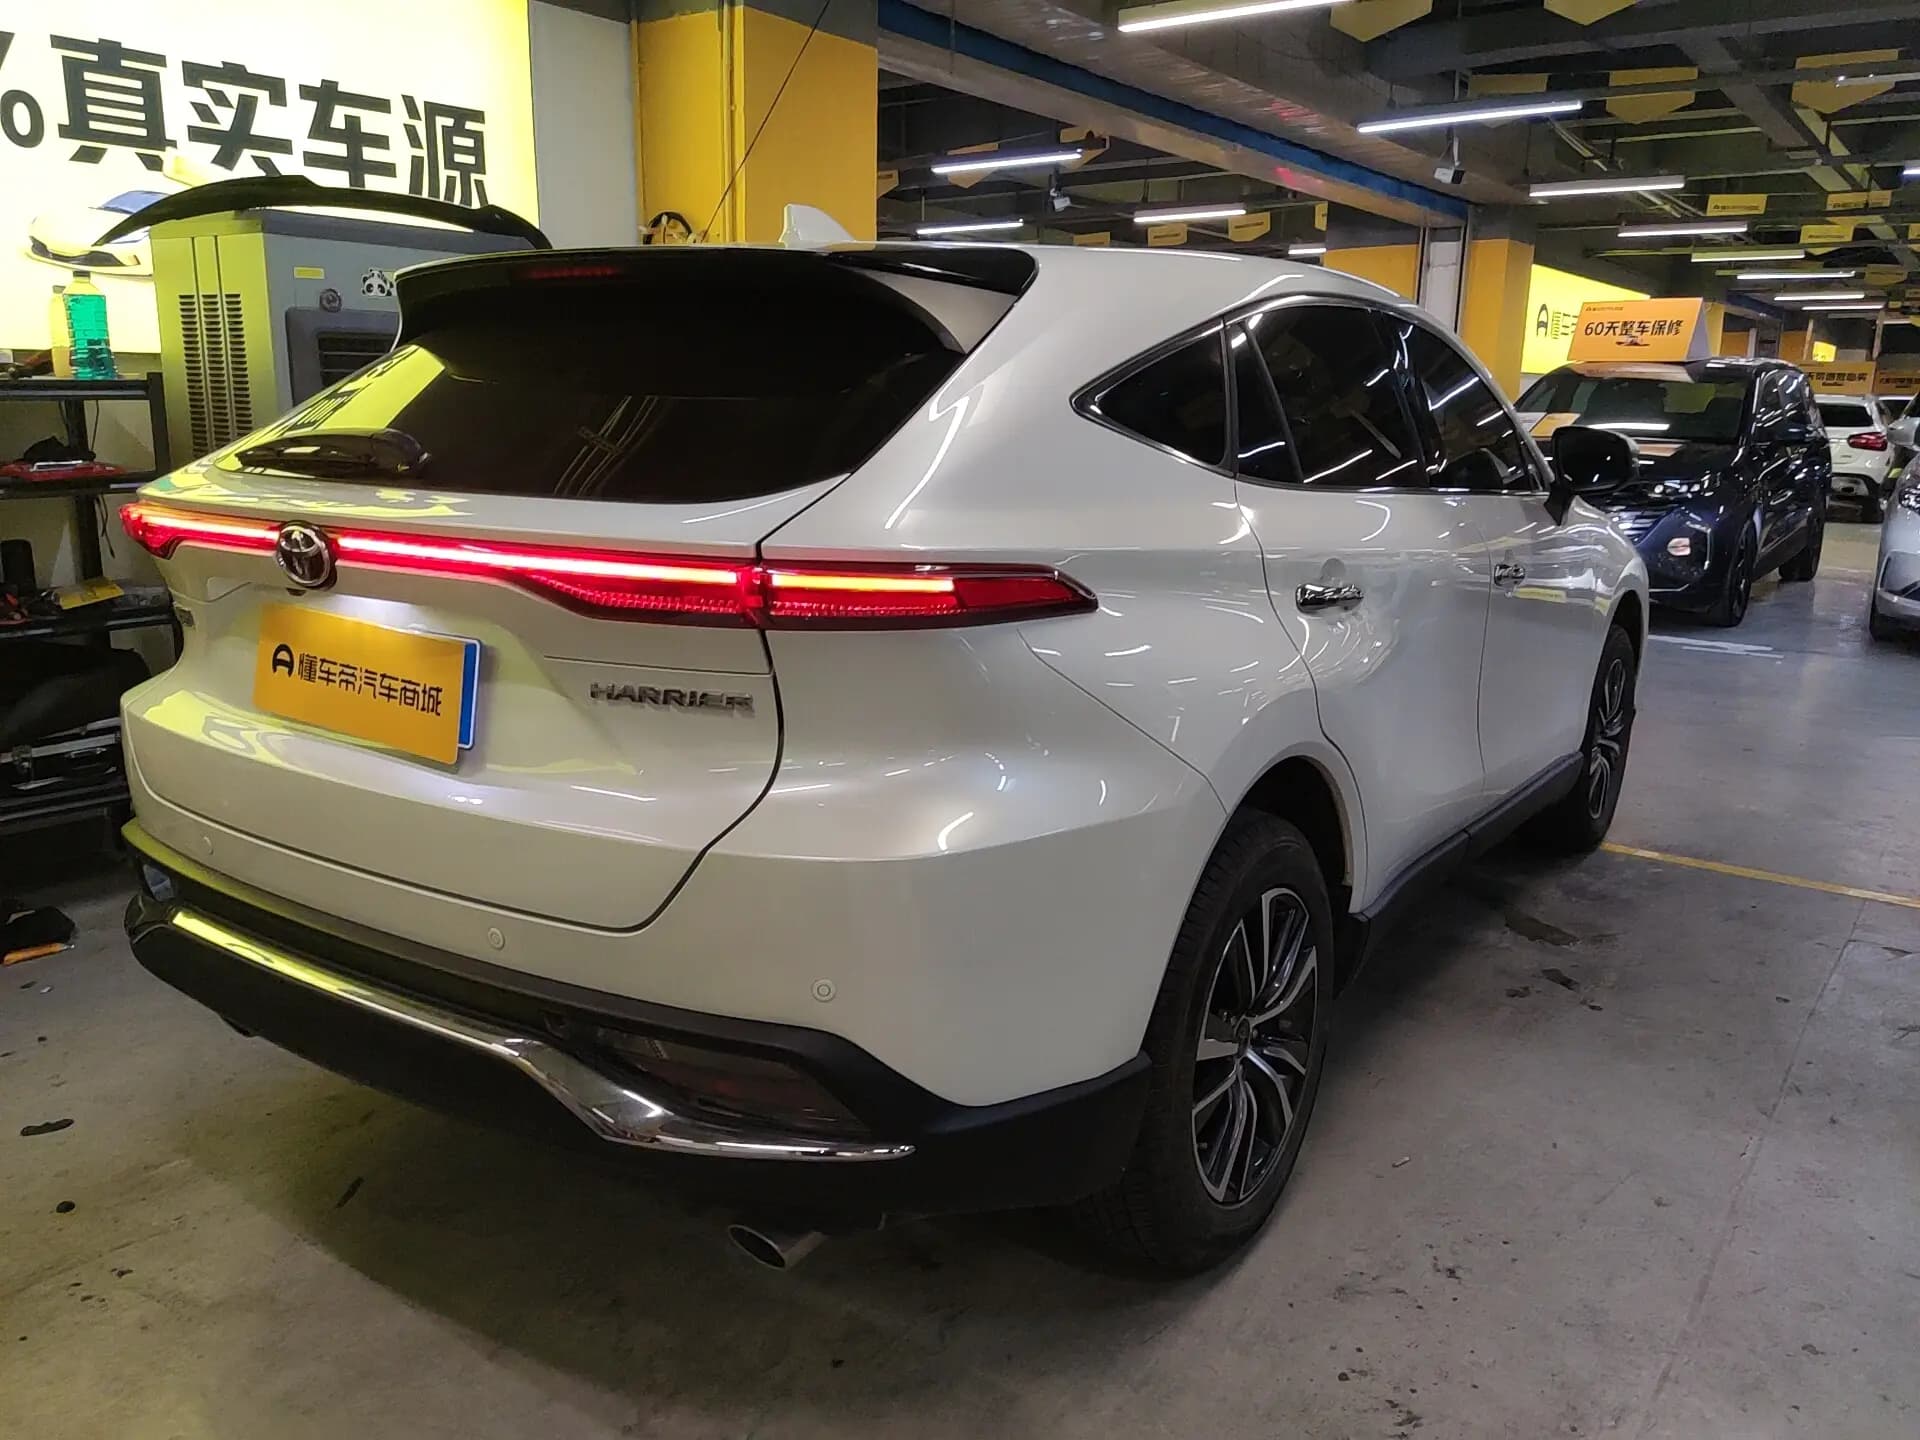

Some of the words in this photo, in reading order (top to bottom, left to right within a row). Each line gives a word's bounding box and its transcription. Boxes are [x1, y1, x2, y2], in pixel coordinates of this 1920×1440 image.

[1583, 319, 1684, 337] 60天整车保修
[298, 652, 443, 717] 懂车帝汽车商城
[589, 681, 754, 714] HARRIER
